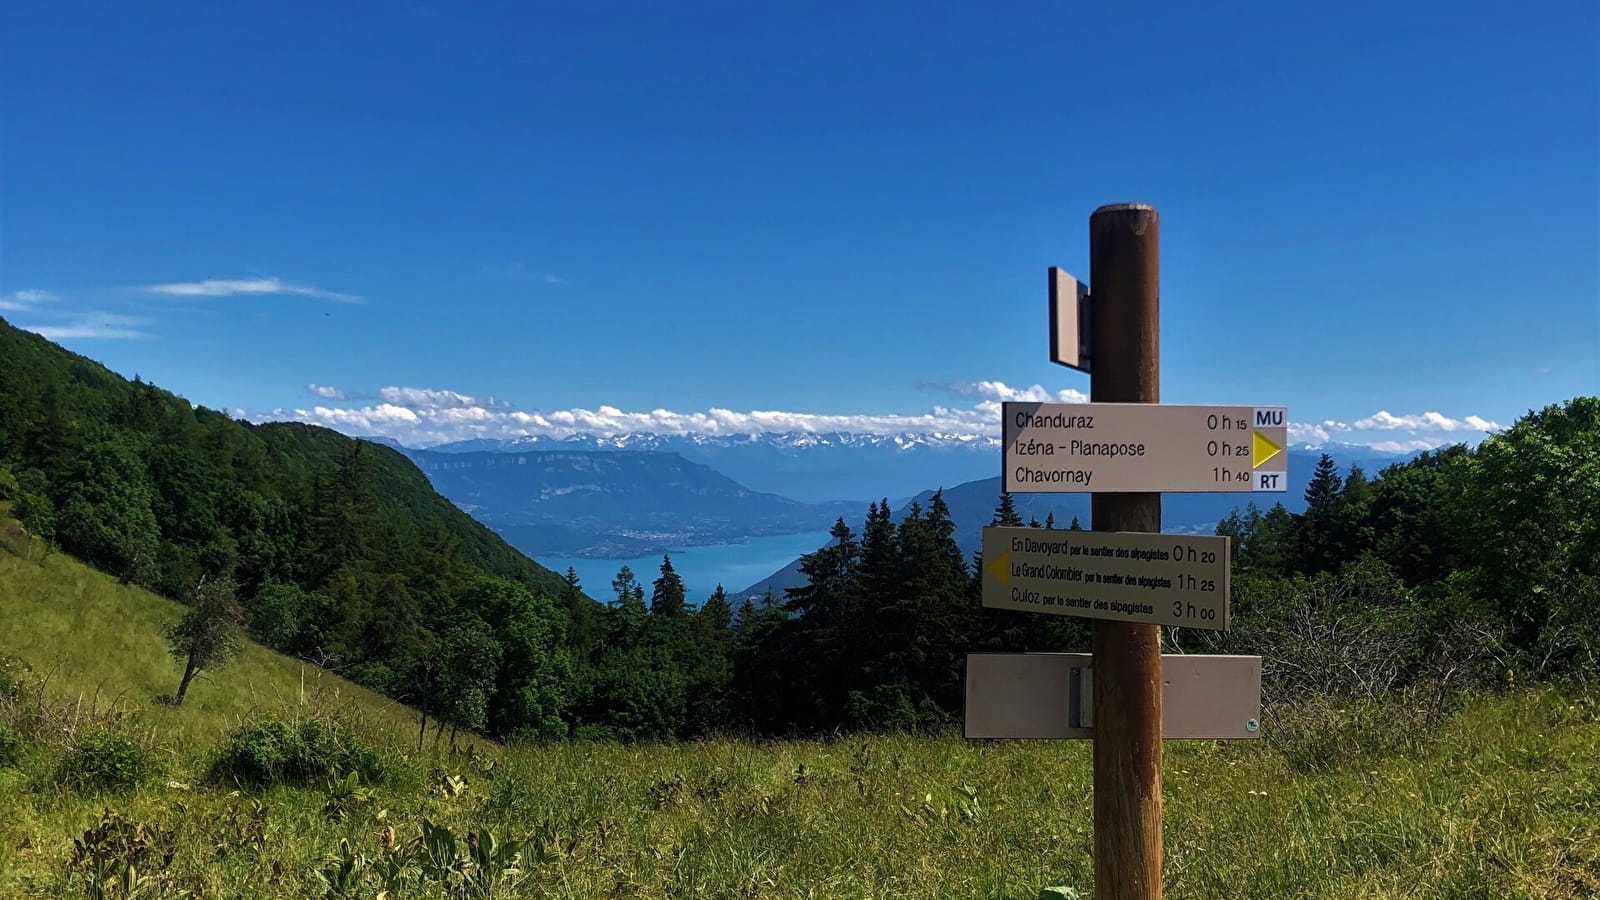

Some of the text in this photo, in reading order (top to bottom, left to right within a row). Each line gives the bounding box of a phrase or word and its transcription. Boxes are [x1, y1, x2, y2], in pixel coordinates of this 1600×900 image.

[1015, 412, 1094, 429] Chanduraz
[1256, 411, 1283, 426] MU
[1015, 438, 1054, 455] Izéna
[1071, 440, 1145, 458] Planapose
[1015, 466, 1092, 485] Chavornay
[1260, 474, 1279, 489] RT
[1012, 537, 1023, 552] En
[1025, 538, 1068, 556] Davoyard
[1070, 546, 1082, 556] par
[1083, 545, 1089, 556] le
[1090, 546, 1114, 557] sentier
[1116, 547, 1129, 558] des
[1130, 548, 1169, 562] alpagistes
[1012, 562, 1020, 577] Le
[1022, 563, 1045, 579] Grand
[1046, 564, 1083, 582] Colombier
[1084, 572, 1095, 584] par
[1096, 572, 1102, 583] le
[1102, 573, 1124, 586] sentier
[1124, 574, 1137, 586] des
[1138, 575, 1172, 590] alpagistes
[1011, 587, 1040, 604] Culoz
[1043, 595, 1056, 606] par
[1057, 595, 1064, 606] le
[1066, 596, 1092, 609] sentier
[1094, 599, 1109, 611] des
[1110, 600, 1153, 615] alpagistes
